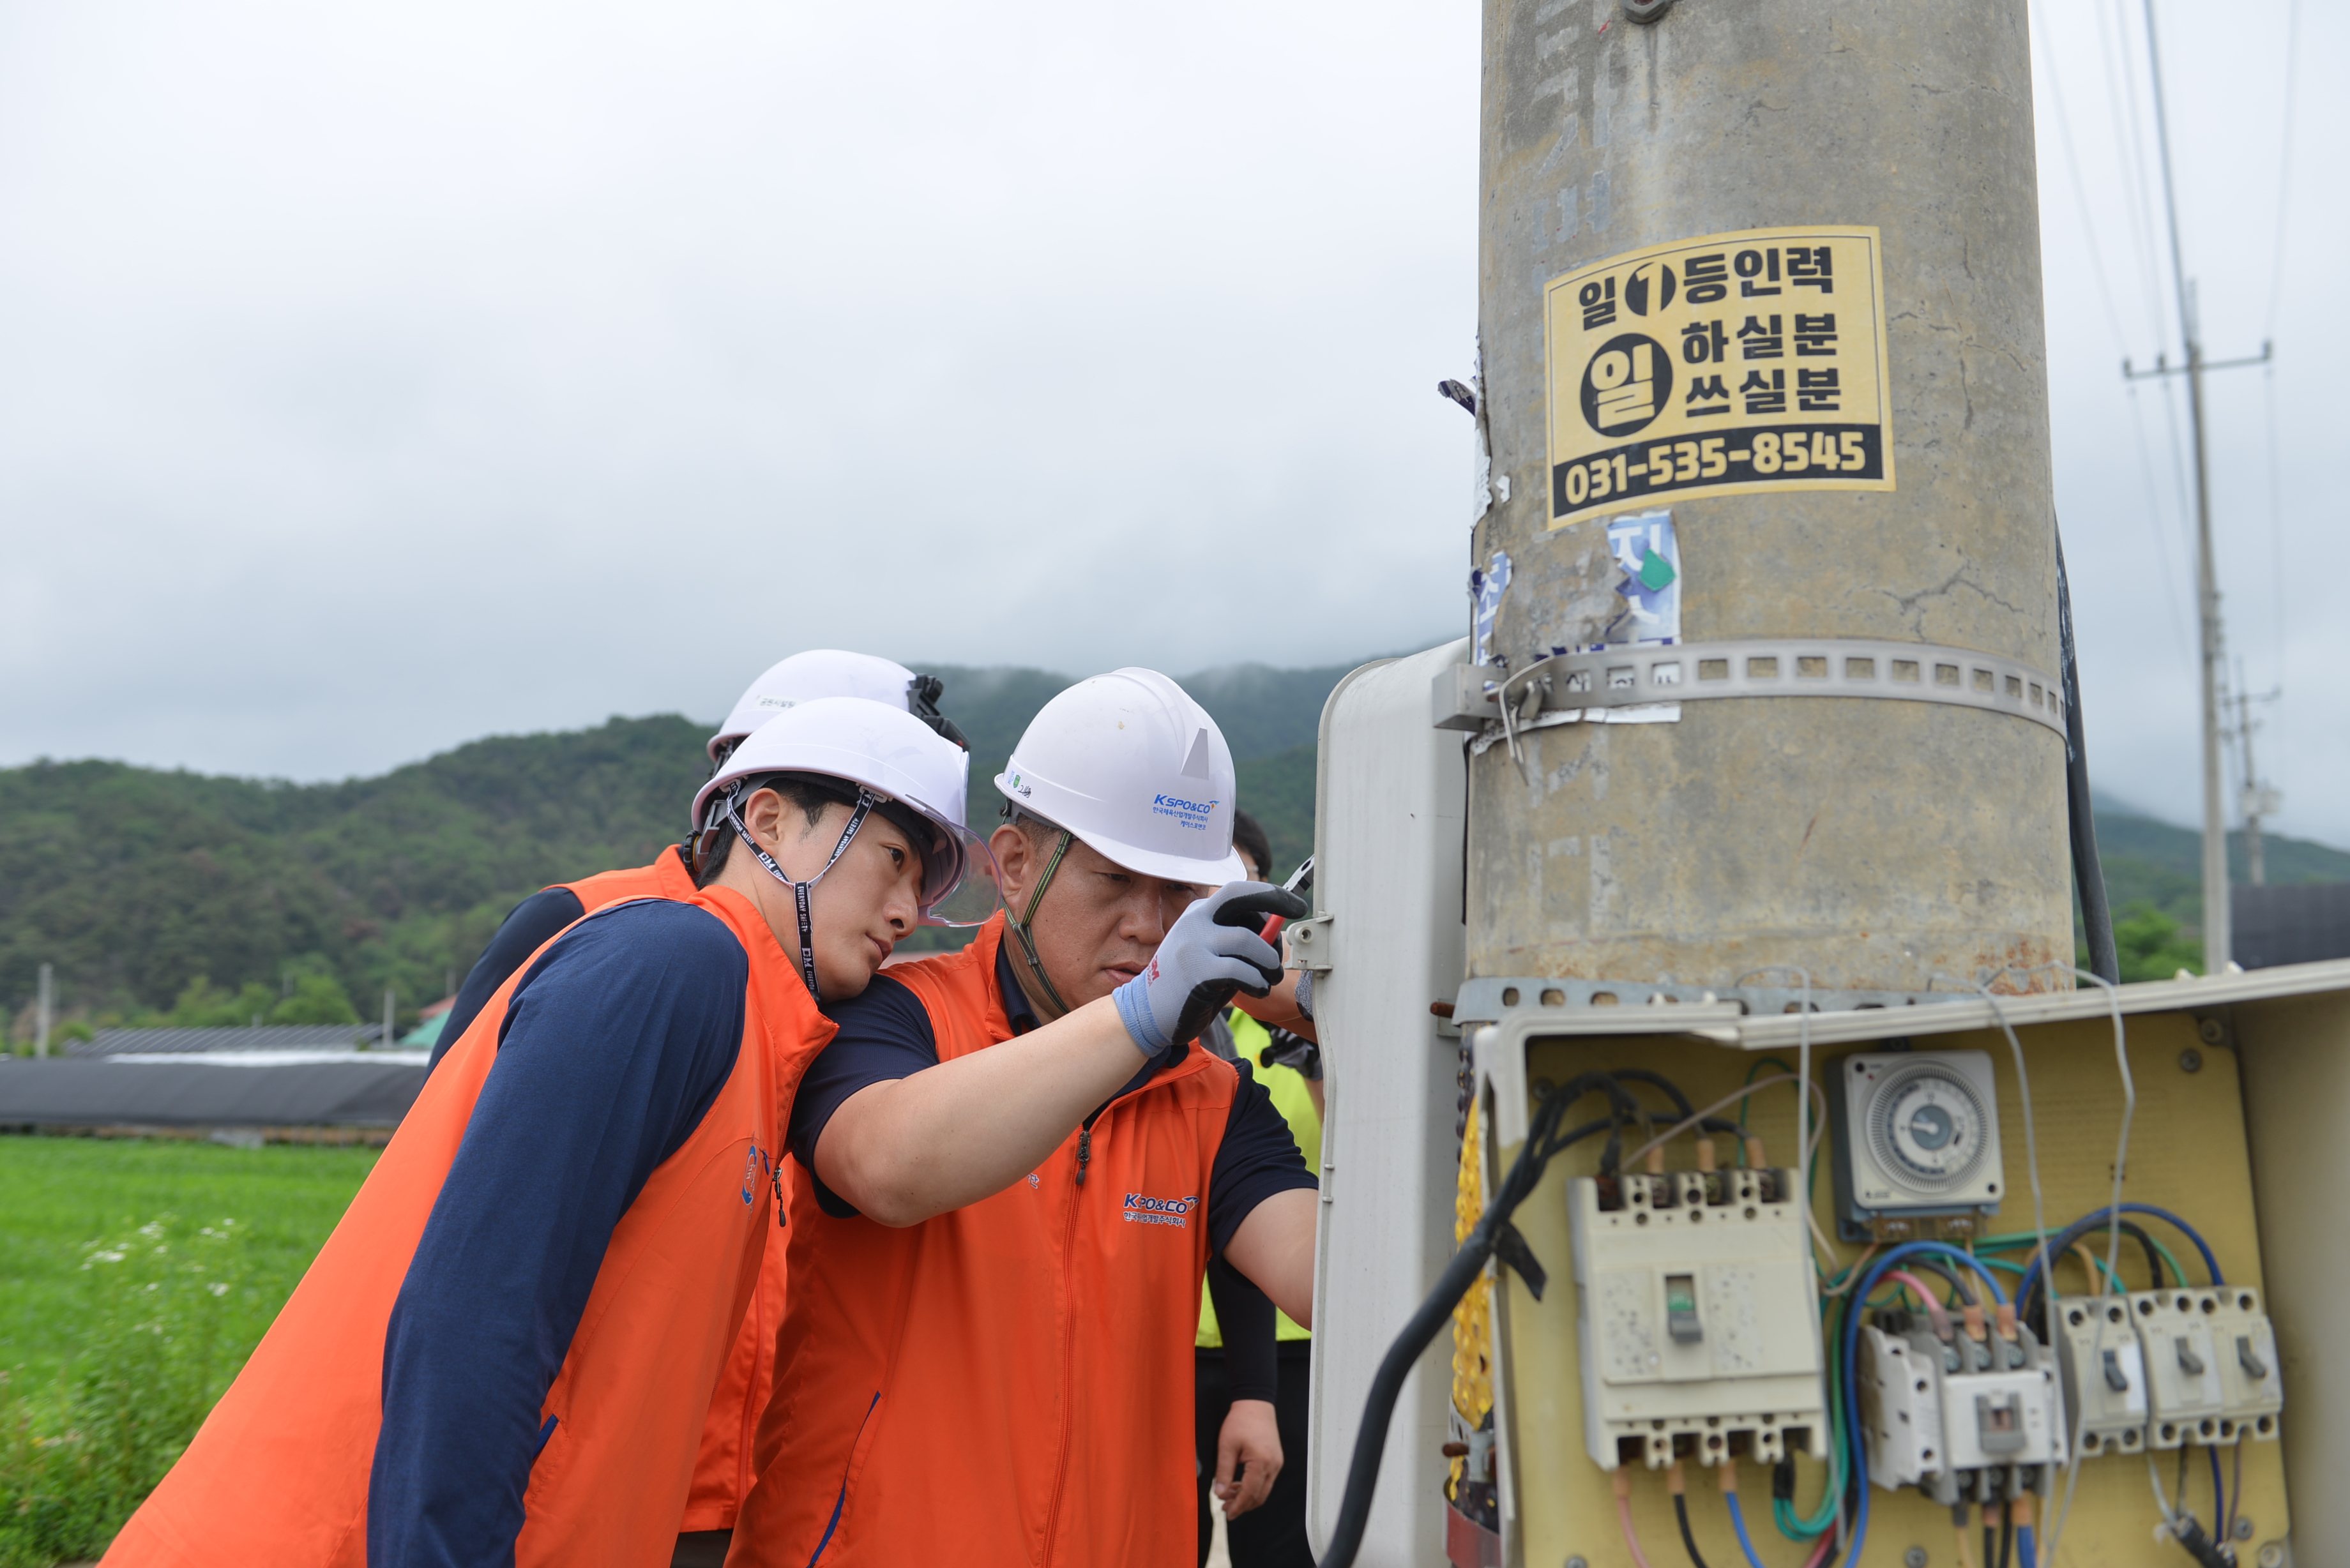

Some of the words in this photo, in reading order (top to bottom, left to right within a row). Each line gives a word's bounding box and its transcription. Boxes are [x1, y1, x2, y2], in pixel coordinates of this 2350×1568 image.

[1591, 343, 1655, 428] 일
[1565, 432, 1865, 504] 031-535-8545
[1153, 794, 1210, 814] KSPO&CO
[729, 813, 743, 833] EVERYDAY
[741, 830, 755, 845] SAFETY
[847, 817, 860, 835] SAFETY
[798, 886, 807, 912] EVERYDAY
[800, 913, 808, 933] SAFETY
[1123, 1193, 1188, 1214] KPO&CO
